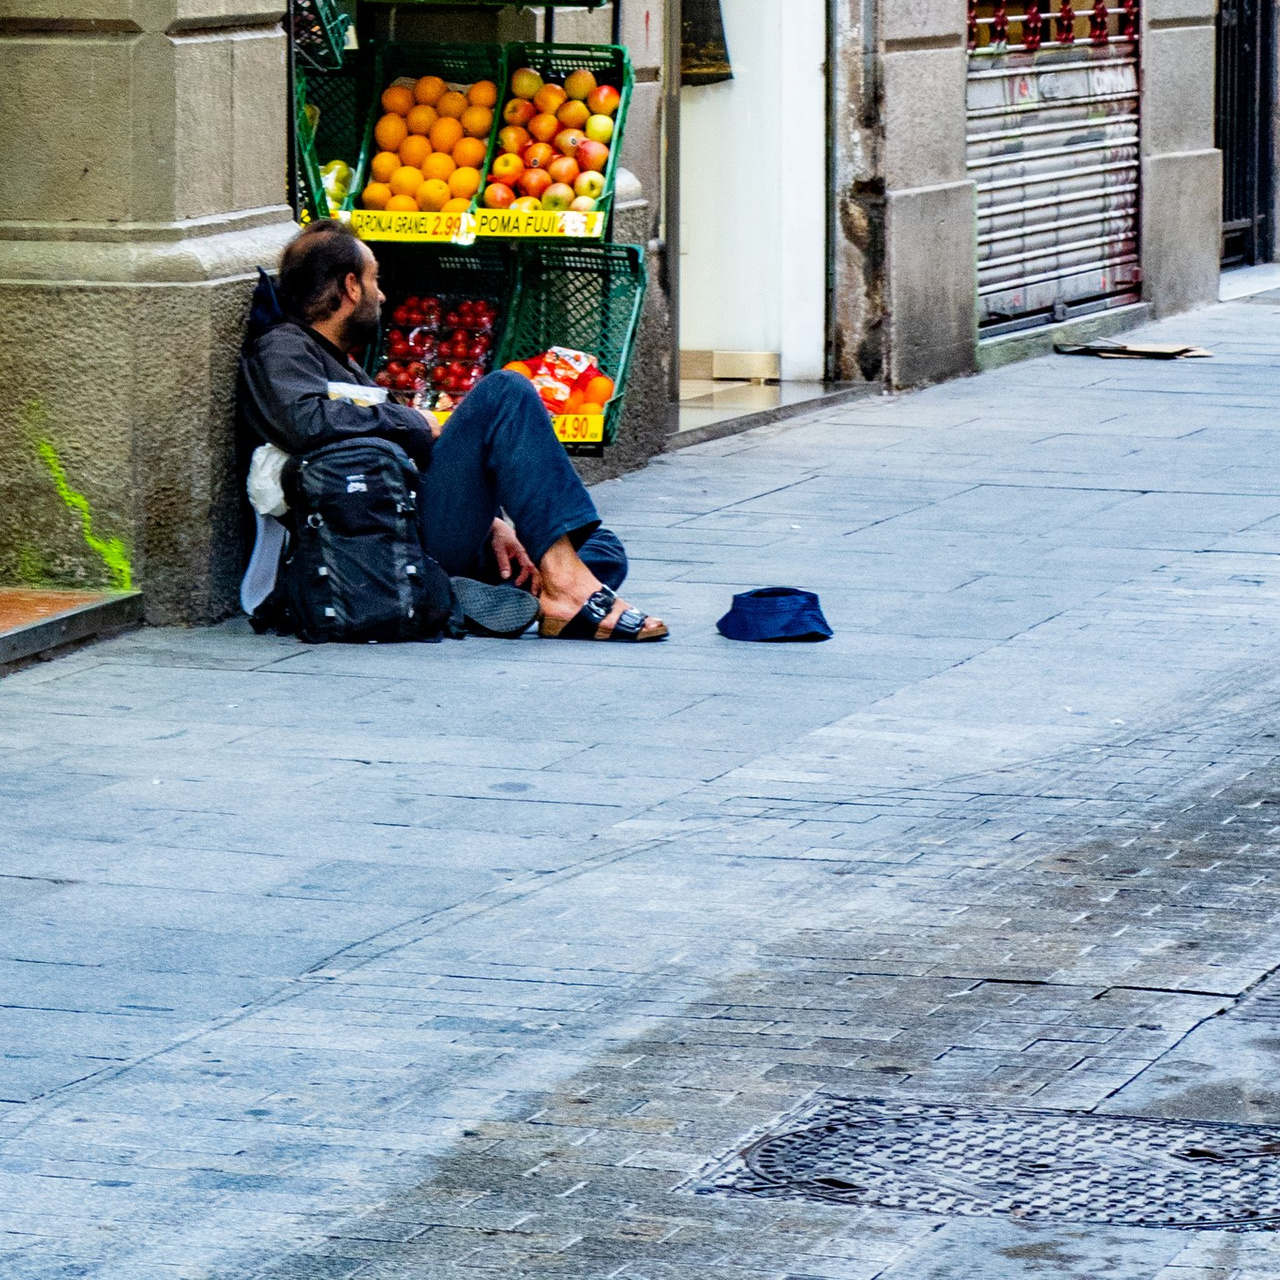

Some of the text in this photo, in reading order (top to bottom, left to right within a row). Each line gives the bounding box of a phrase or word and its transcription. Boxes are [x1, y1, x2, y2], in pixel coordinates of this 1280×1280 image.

[395, 215, 428, 234] GRANEL
[479, 215, 520, 233] POMA
[525, 216, 556, 233] FUJI
[559, 416, 588, 439] 4.90
